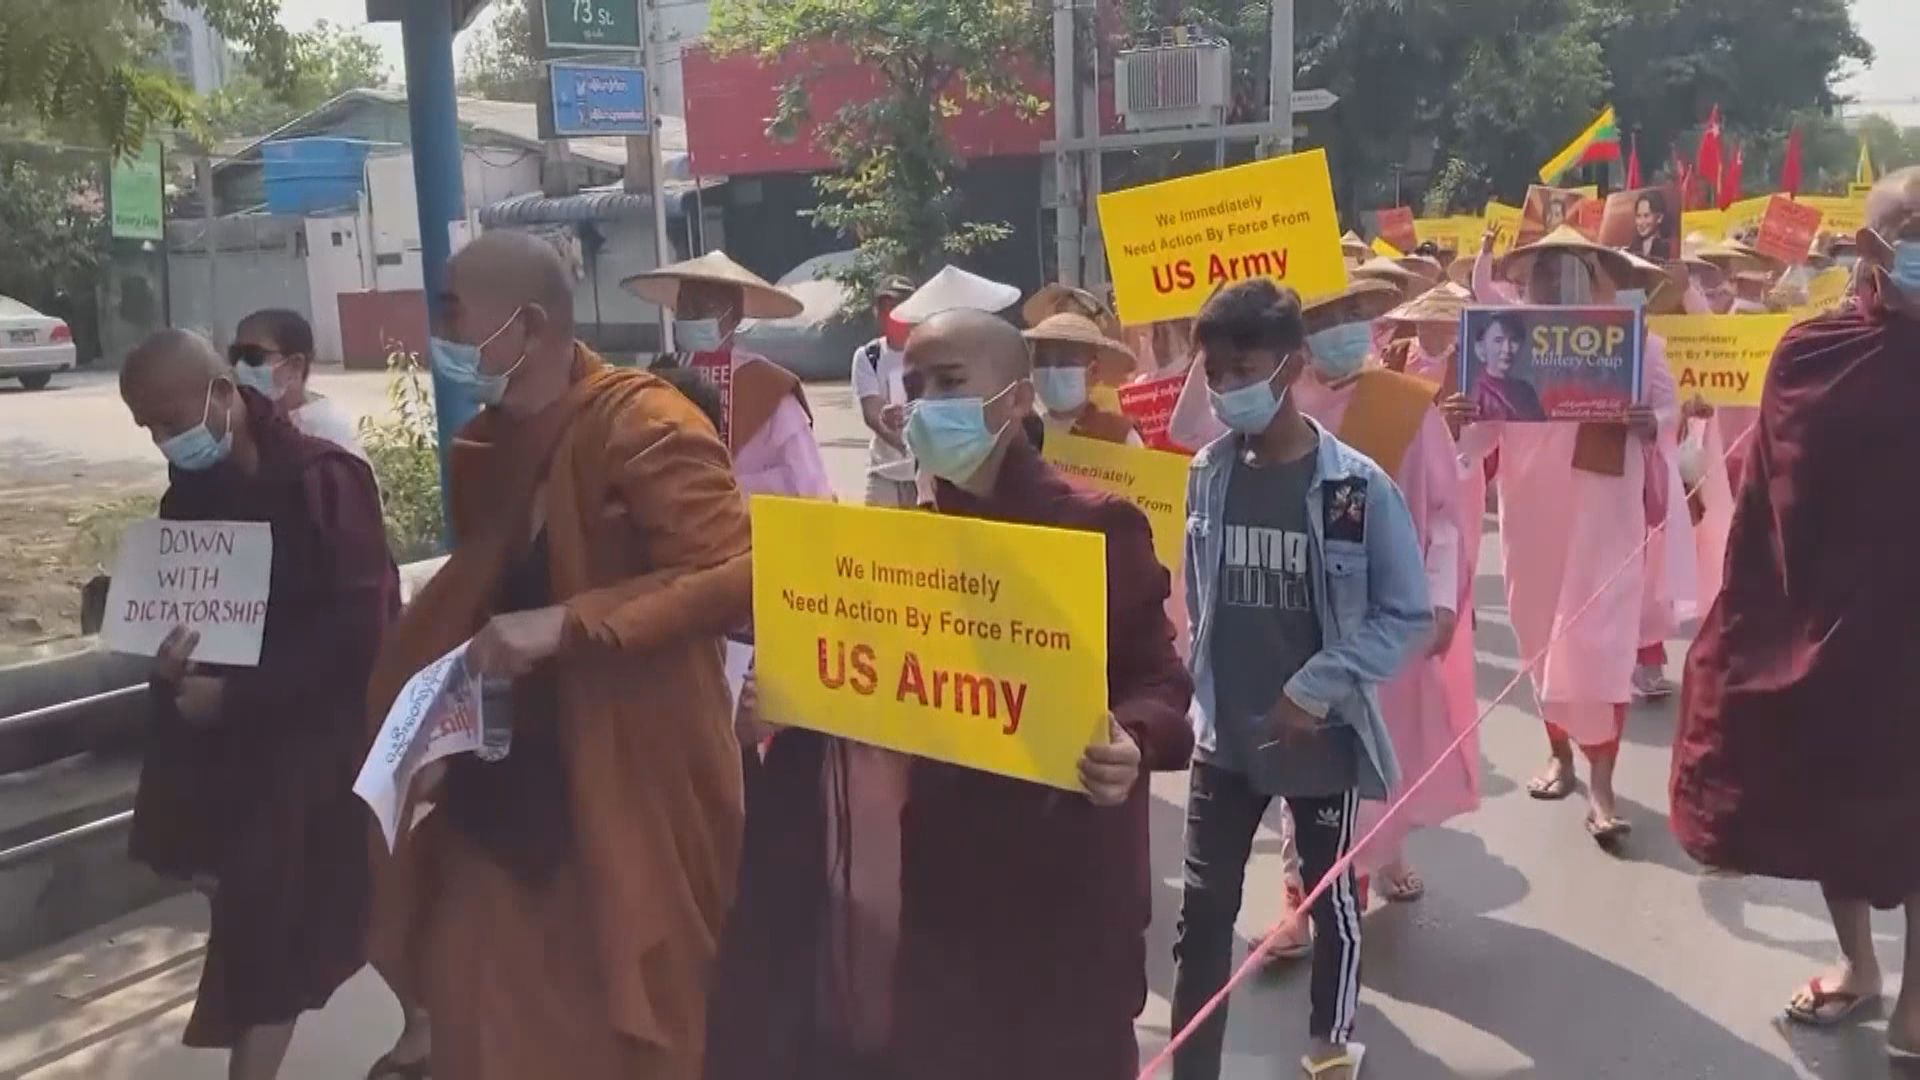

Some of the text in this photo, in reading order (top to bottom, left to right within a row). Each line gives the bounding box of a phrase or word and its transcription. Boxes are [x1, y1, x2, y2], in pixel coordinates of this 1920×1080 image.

[1155, 195, 1263, 227] We Immediately
[1122, 210, 1311, 257] Need Action By Force From
[1152, 248, 1288, 294] US Army
[1531, 325, 1625, 358] STOP
[700, 364, 730, 385] REE
[1680, 367, 1750, 393] Army
[1136, 495, 1173, 513] From
[159, 527, 235, 556] DOWN
[1224, 525, 1309, 574] UMA
[157, 566, 220, 591] WITH
[835, 555, 1000, 603] We Immediately
[124, 600, 266, 625] DICTATORSHIP
[782, 587, 1071, 651] Need Action By Force From
[817, 637, 1028, 736] US Army
